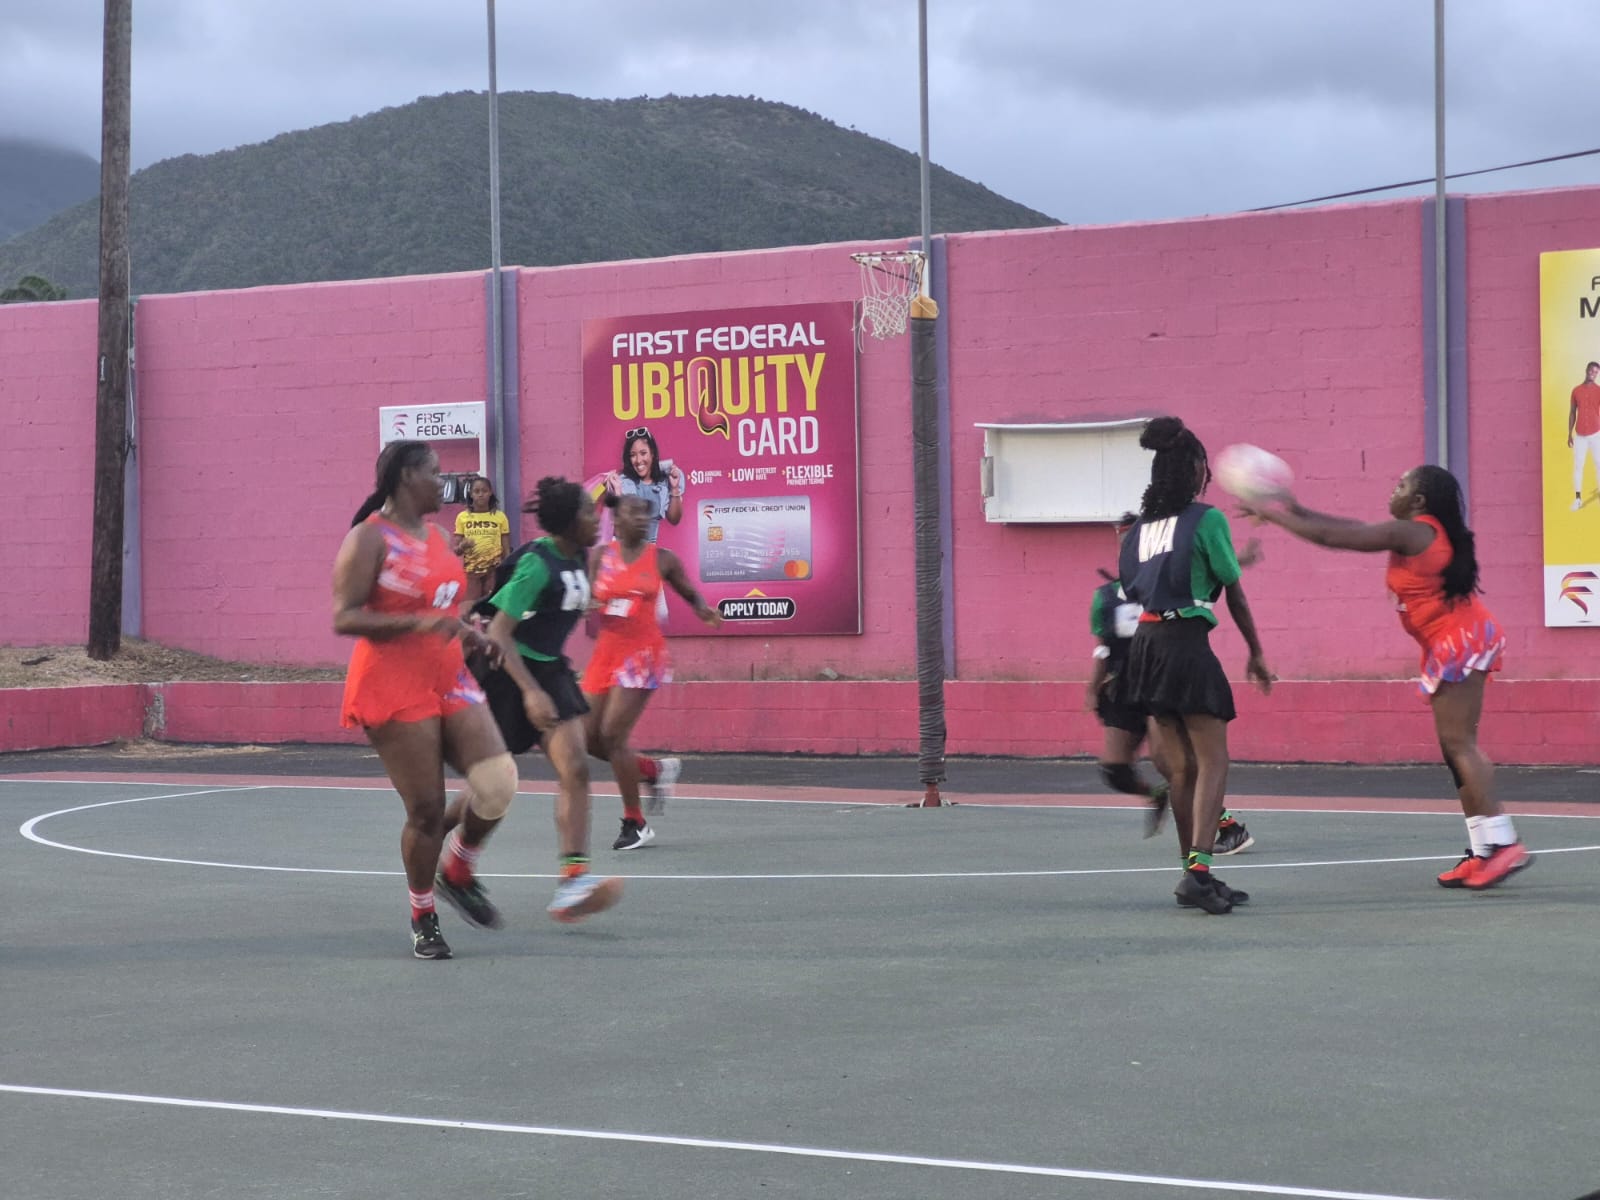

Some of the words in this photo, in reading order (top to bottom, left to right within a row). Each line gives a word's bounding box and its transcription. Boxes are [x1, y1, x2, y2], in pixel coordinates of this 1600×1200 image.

[612, 329, 689, 358] FIRST
[695, 321, 826, 353] FEDERAL
[416, 423, 470, 437] FEDERAL
[737, 416, 820, 457] CARD
[690, 469, 704, 486] $0
[732, 467, 755, 482] LOW
[785, 464, 834, 479] FLEXIBLE
[723, 602, 755, 616] APPLY
[756, 601, 789, 616] TODAY
